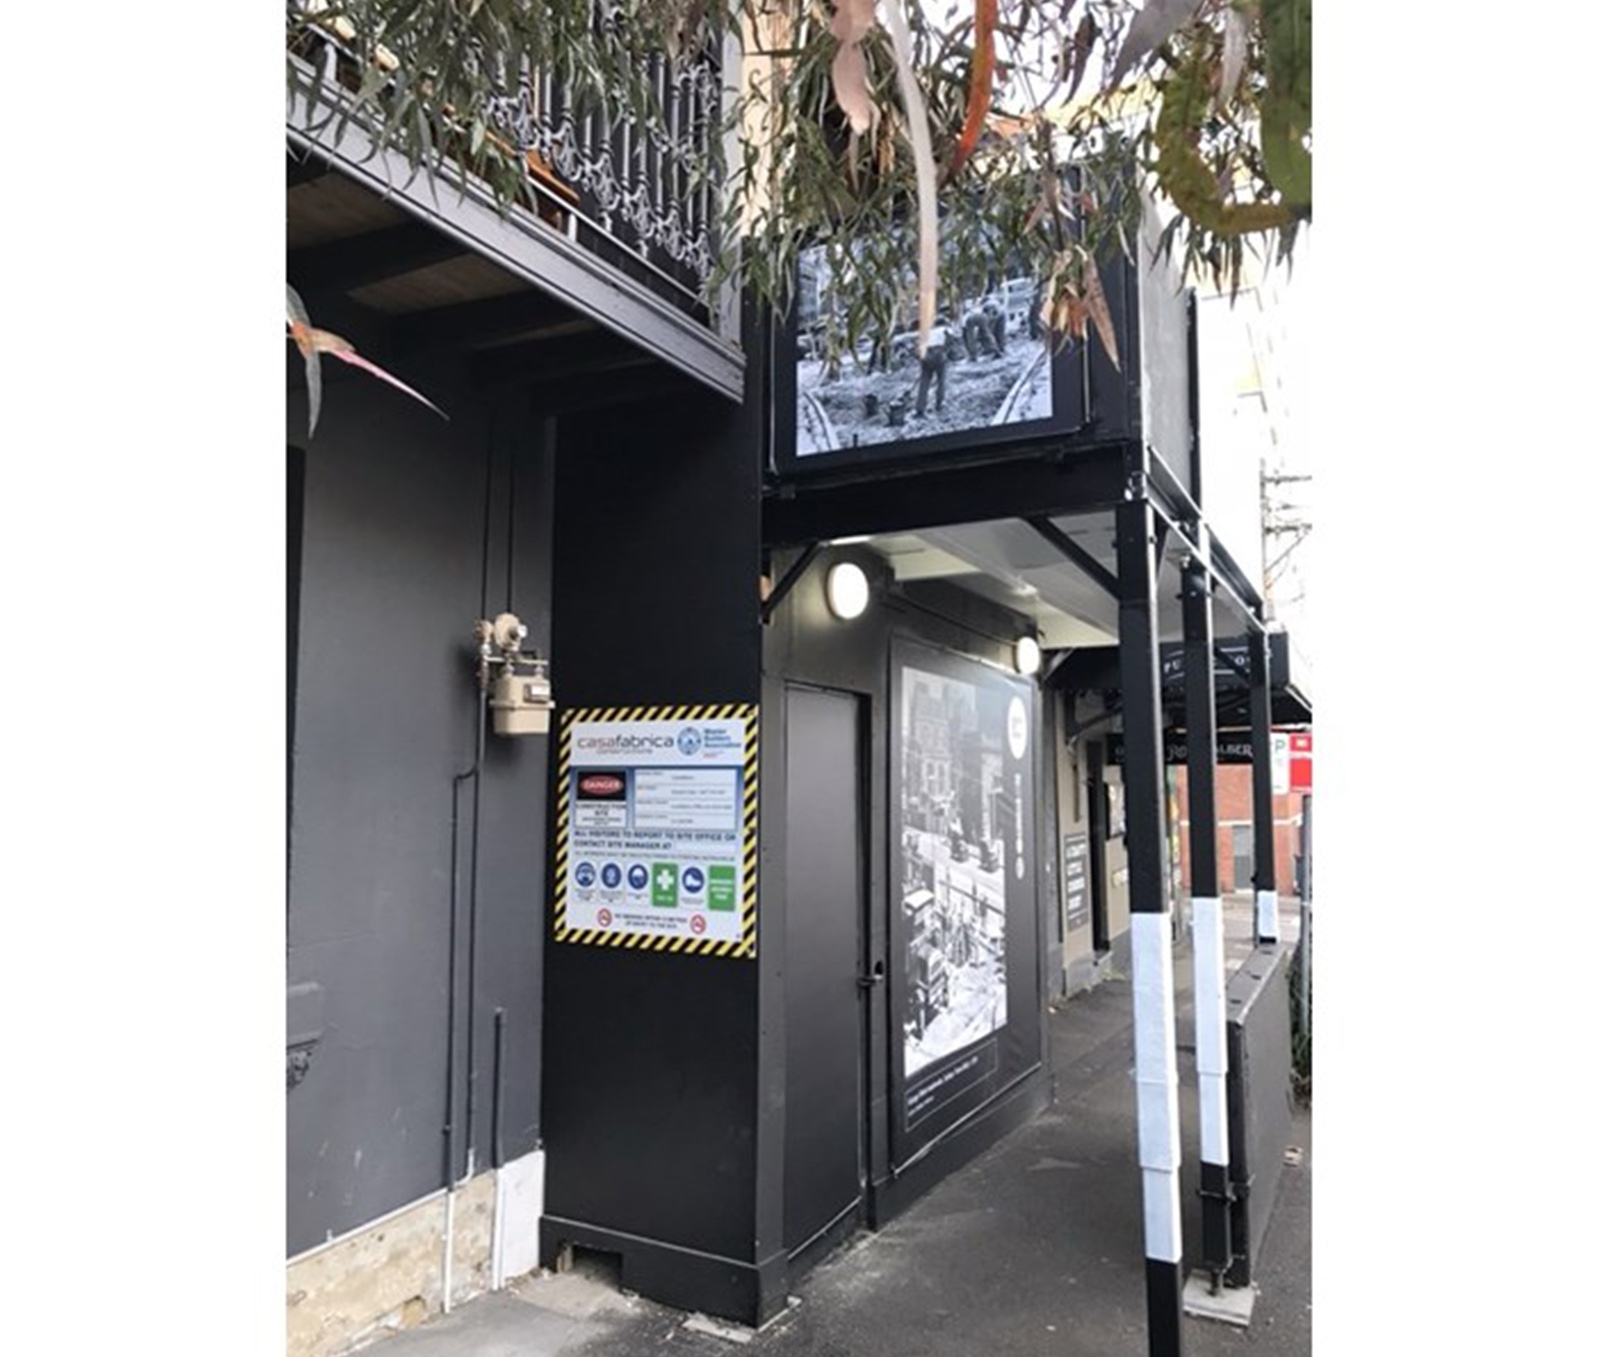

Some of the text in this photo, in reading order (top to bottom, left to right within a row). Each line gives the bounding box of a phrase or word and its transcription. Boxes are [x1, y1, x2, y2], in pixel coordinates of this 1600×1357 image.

[577, 734, 674, 749] casafabrica
[589, 831, 621, 839] VISITORS
[664, 832, 675, 840] TO
[677, 832, 693, 841] SITE
[694, 833, 722, 841] OFFICE
[573, 840, 606, 848] CONTACT
[625, 841, 661, 849] MANAGER
